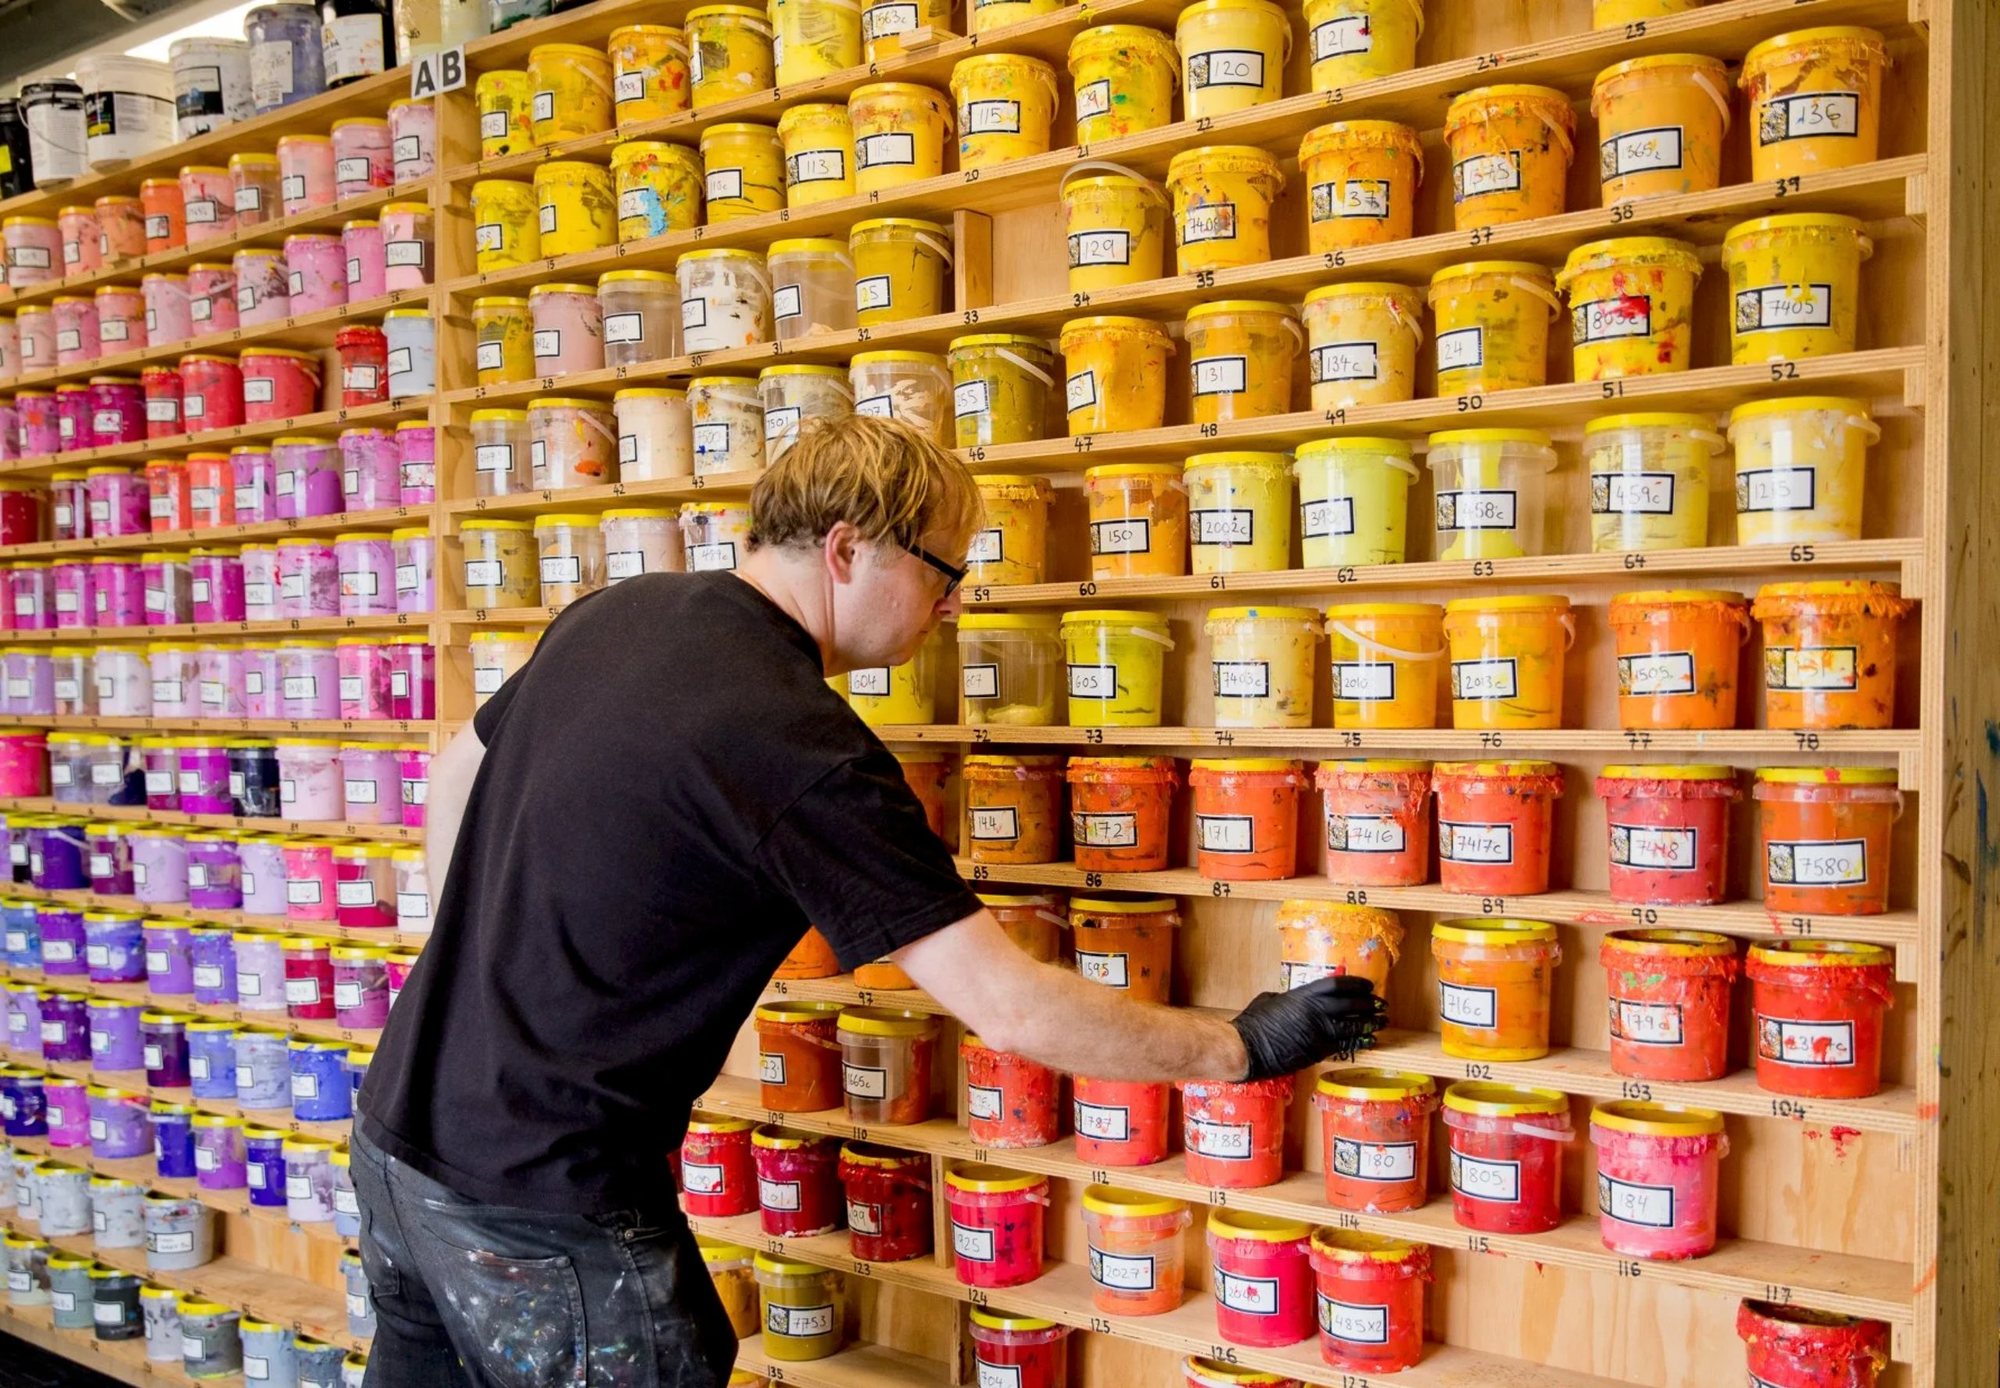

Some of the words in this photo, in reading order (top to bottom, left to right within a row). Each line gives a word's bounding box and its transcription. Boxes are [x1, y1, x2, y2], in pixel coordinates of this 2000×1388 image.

[1321, 28, 1344, 48] 121
[1625, 21, 1647, 39] 25
[969, 35, 979, 48] 7
[870, 63, 878, 75] 6
[1213, 59, 1251, 79] 120
[1477, 54, 1499, 71] 24
[773, 88, 781, 100] 5
[1325, 88, 1344, 102] 23
[979, 106, 1002, 125] 115
[1196, 118, 1214, 131] 22
[1077, 145, 1090, 158] 21
[806, 158, 830, 177] 113
[965, 169, 980, 182] 20
[1775, 176, 1800, 197] 39
[869, 190, 879, 202] 19
[780, 210, 790, 222] 18
[1609, 204, 1634, 224] 38
[694, 229, 704, 240] 17
[1470, 226, 1494, 246] 37
[616, 246, 626, 256] 16
[1084, 238, 1115, 259] 129
[1325, 253, 1346, 269] 36
[1197, 273, 1215, 288] 35
[1074, 293, 1091, 307] 34
[1767, 299, 1815, 318] 7405
[964, 311, 980, 325] 33
[858, 328, 872, 341] 32
[773, 343, 784, 355] 31
[691, 356, 703, 367] 30
[1326, 355, 1363, 375] 134c
[616, 367, 627, 379] 29
[1204, 366, 1224, 384] 131
[1770, 362, 1800, 381] 52
[1601, 381, 1624, 399] 51
[1457, 395, 1483, 412] 50
[1325, 410, 1346, 425] 49
[1200, 423, 1219, 437] 48
[1075, 436, 1094, 452] 47
[969, 447, 985, 461] 46
[613, 484, 626, 497] 42
[692, 476, 705, 489] 43
[1615, 486, 1661, 506] 459c
[1107, 529, 1133, 544] 150
[1624, 554, 1647, 570] 64
[1790, 545, 1816, 563] 65
[1337, 569, 1358, 583] 62
[1473, 562, 1495, 577] 63
[1079, 582, 1097, 597] 60
[1210, 575, 1226, 590] 61
[974, 588, 990, 602] 59
[852, 674, 877, 691] 604
[1075, 673, 1099, 690] 605
[1465, 674, 1507, 690] 2013c
[973, 729, 991, 743] 72
[1085, 729, 1104, 744] 73
[1214, 731, 1235, 747] 74
[1340, 732, 1362, 747] 75
[1480, 733, 1503, 748] 76
[1624, 731, 1652, 750] 77
[1793, 731, 1820, 751] 78
[1093, 820, 1124, 839] 172
[1207, 824, 1229, 843] 171
[1350, 826, 1394, 846] 7416
[1456, 836, 1503, 856] 7417c
[973, 866, 989, 880] 85
[1799, 857, 1851, 877] 7580
[1086, 873, 1102, 887] 86
[1212, 882, 1231, 897] 87
[1347, 890, 1368, 905] 88
[1482, 898, 1505, 915] 89
[1631, 908, 1658, 925] 90
[1792, 917, 1813, 935] 91
[775, 982, 788, 995] 96
[858, 992, 874, 1007] 97
[1446, 993, 1482, 1018] 716c
[1465, 1064, 1493, 1081] 102
[1623, 1082, 1653, 1101] 103
[1771, 1100, 1807, 1119] 104
[768, 1111, 785, 1126] 109
[852, 1127, 868, 1140] 110
[975, 1148, 988, 1162] 111
[1367, 1152, 1395, 1169] 180
[1092, 1171, 1110, 1185] 112
[1209, 1191, 1227, 1206] 113
[1340, 1213, 1360, 1229] 114
[768, 1240, 787, 1256] 122
[1468, 1235, 1490, 1253] 115
[853, 1262, 871, 1278] 123
[1104, 1265, 1141, 1281] 2027
[1618, 1260, 1642, 1278] 116
[968, 1288, 988, 1306] 124
[1766, 1284, 1793, 1304] 117
[1090, 1317, 1111, 1334] 125
[1211, 1345, 1238, 1364] 126
[767, 1364, 785, 1380] 135
